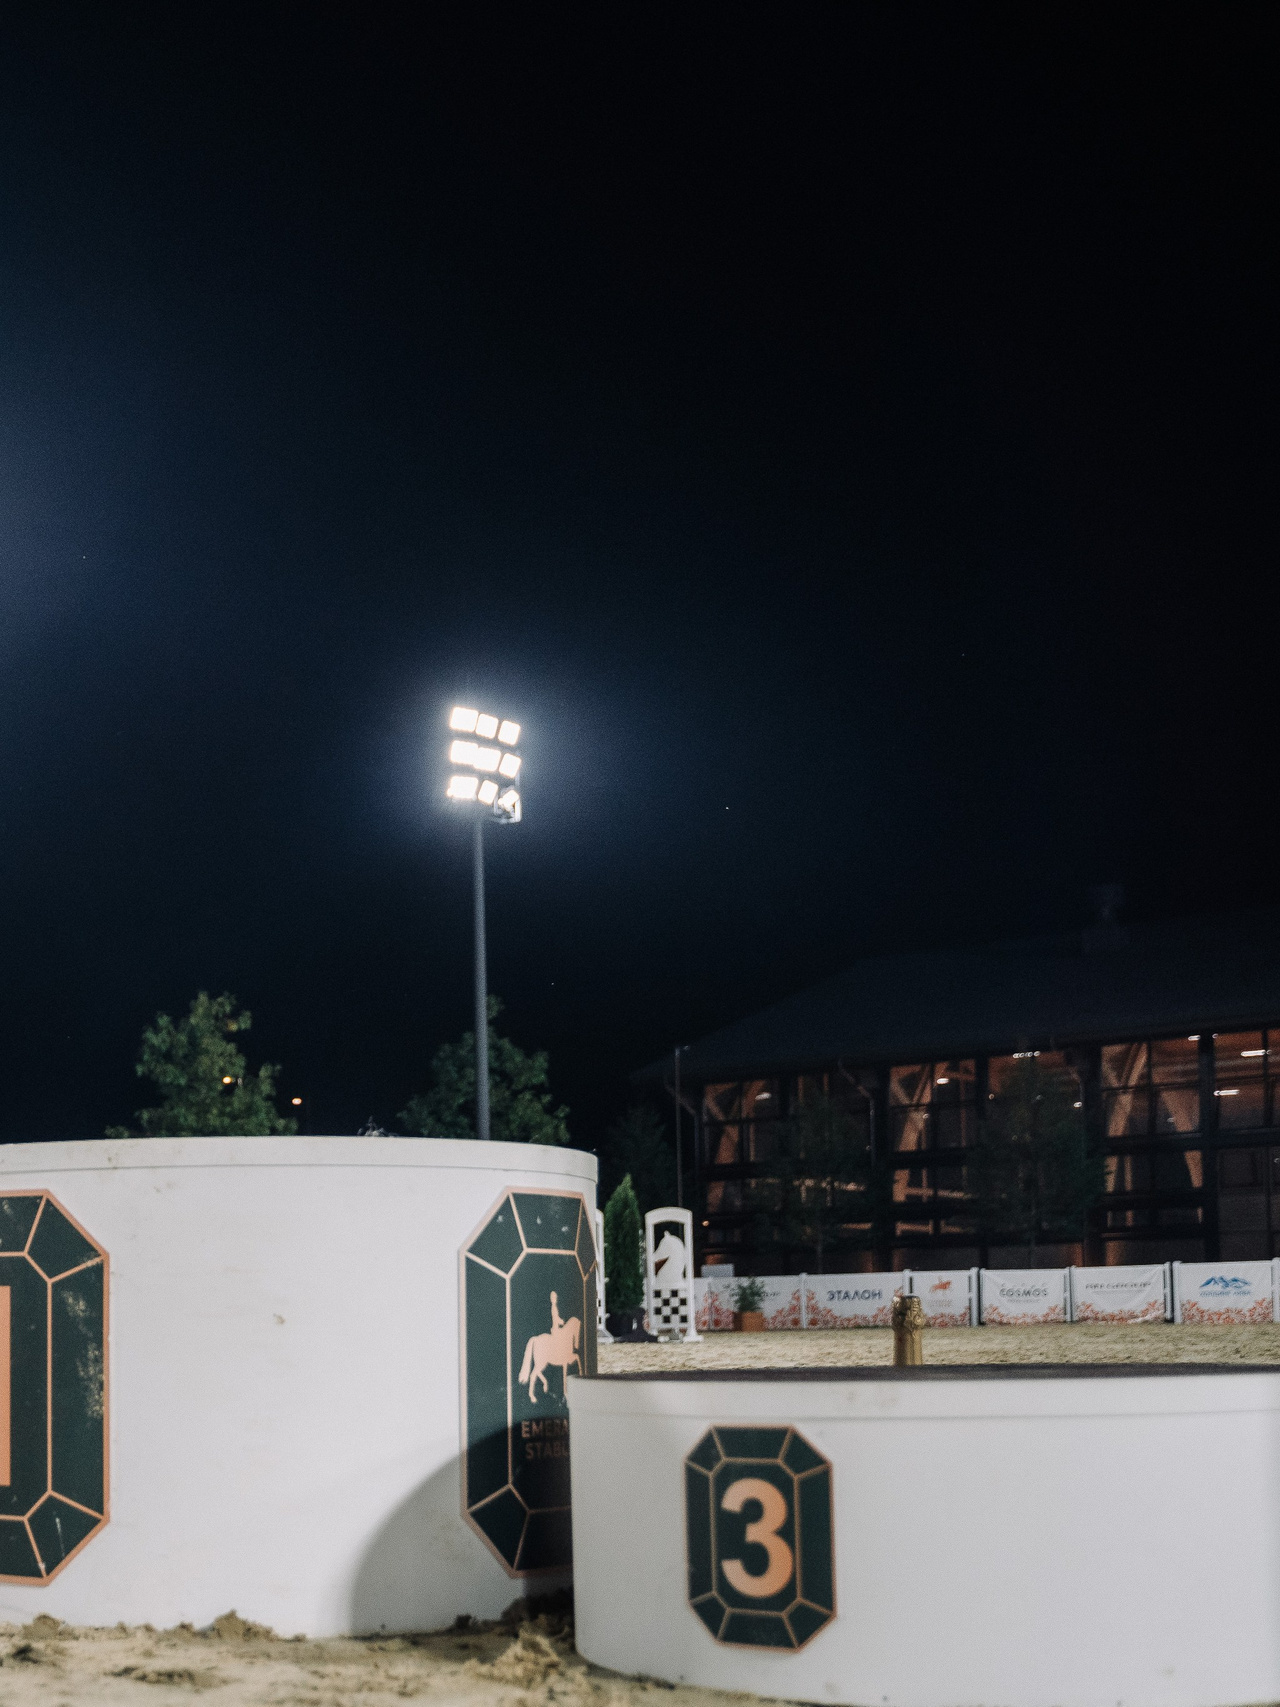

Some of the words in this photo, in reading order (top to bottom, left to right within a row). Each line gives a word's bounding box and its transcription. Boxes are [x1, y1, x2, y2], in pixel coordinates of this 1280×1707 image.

[826, 1289, 882, 1301] ЭТАЛОН
[999, 1287, 1049, 1298] COSMOS
[521, 1418, 569, 1438] EMERA
[525, 1440, 569, 1460] STABL
[721, 1477, 794, 1598] 3
